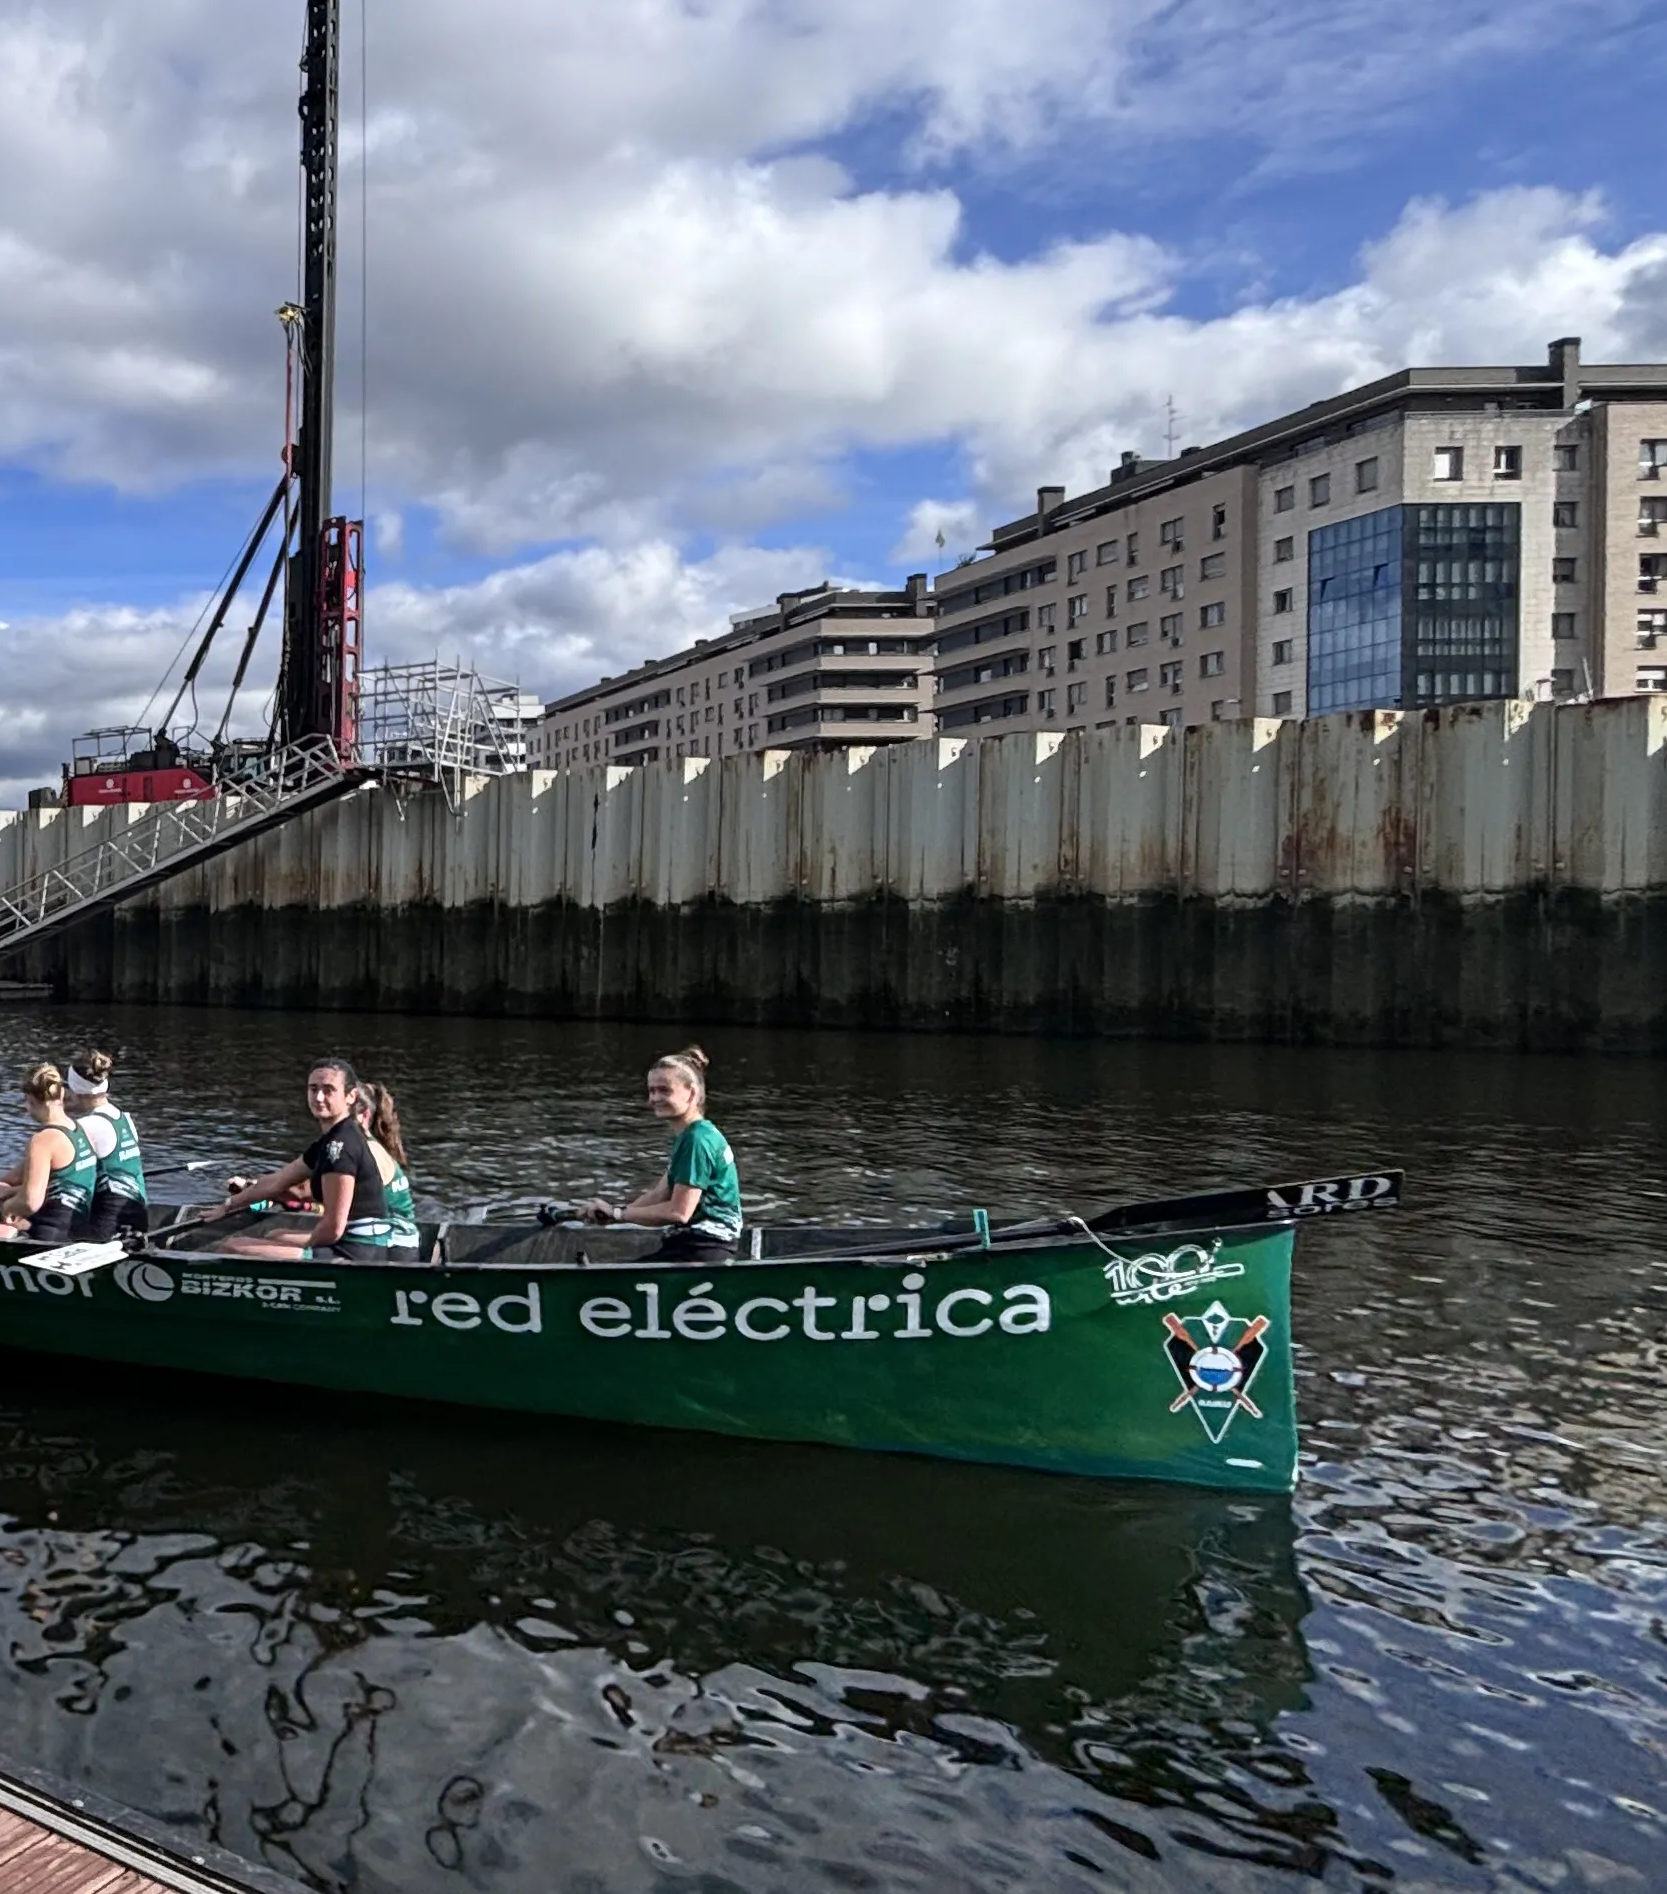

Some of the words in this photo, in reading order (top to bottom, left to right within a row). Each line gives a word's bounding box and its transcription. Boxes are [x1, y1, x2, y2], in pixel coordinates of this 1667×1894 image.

[180, 1278, 302, 1302] BIZKOR
[390, 1282, 542, 1333] red
[579, 1273, 1050, 1341] eléctrica
